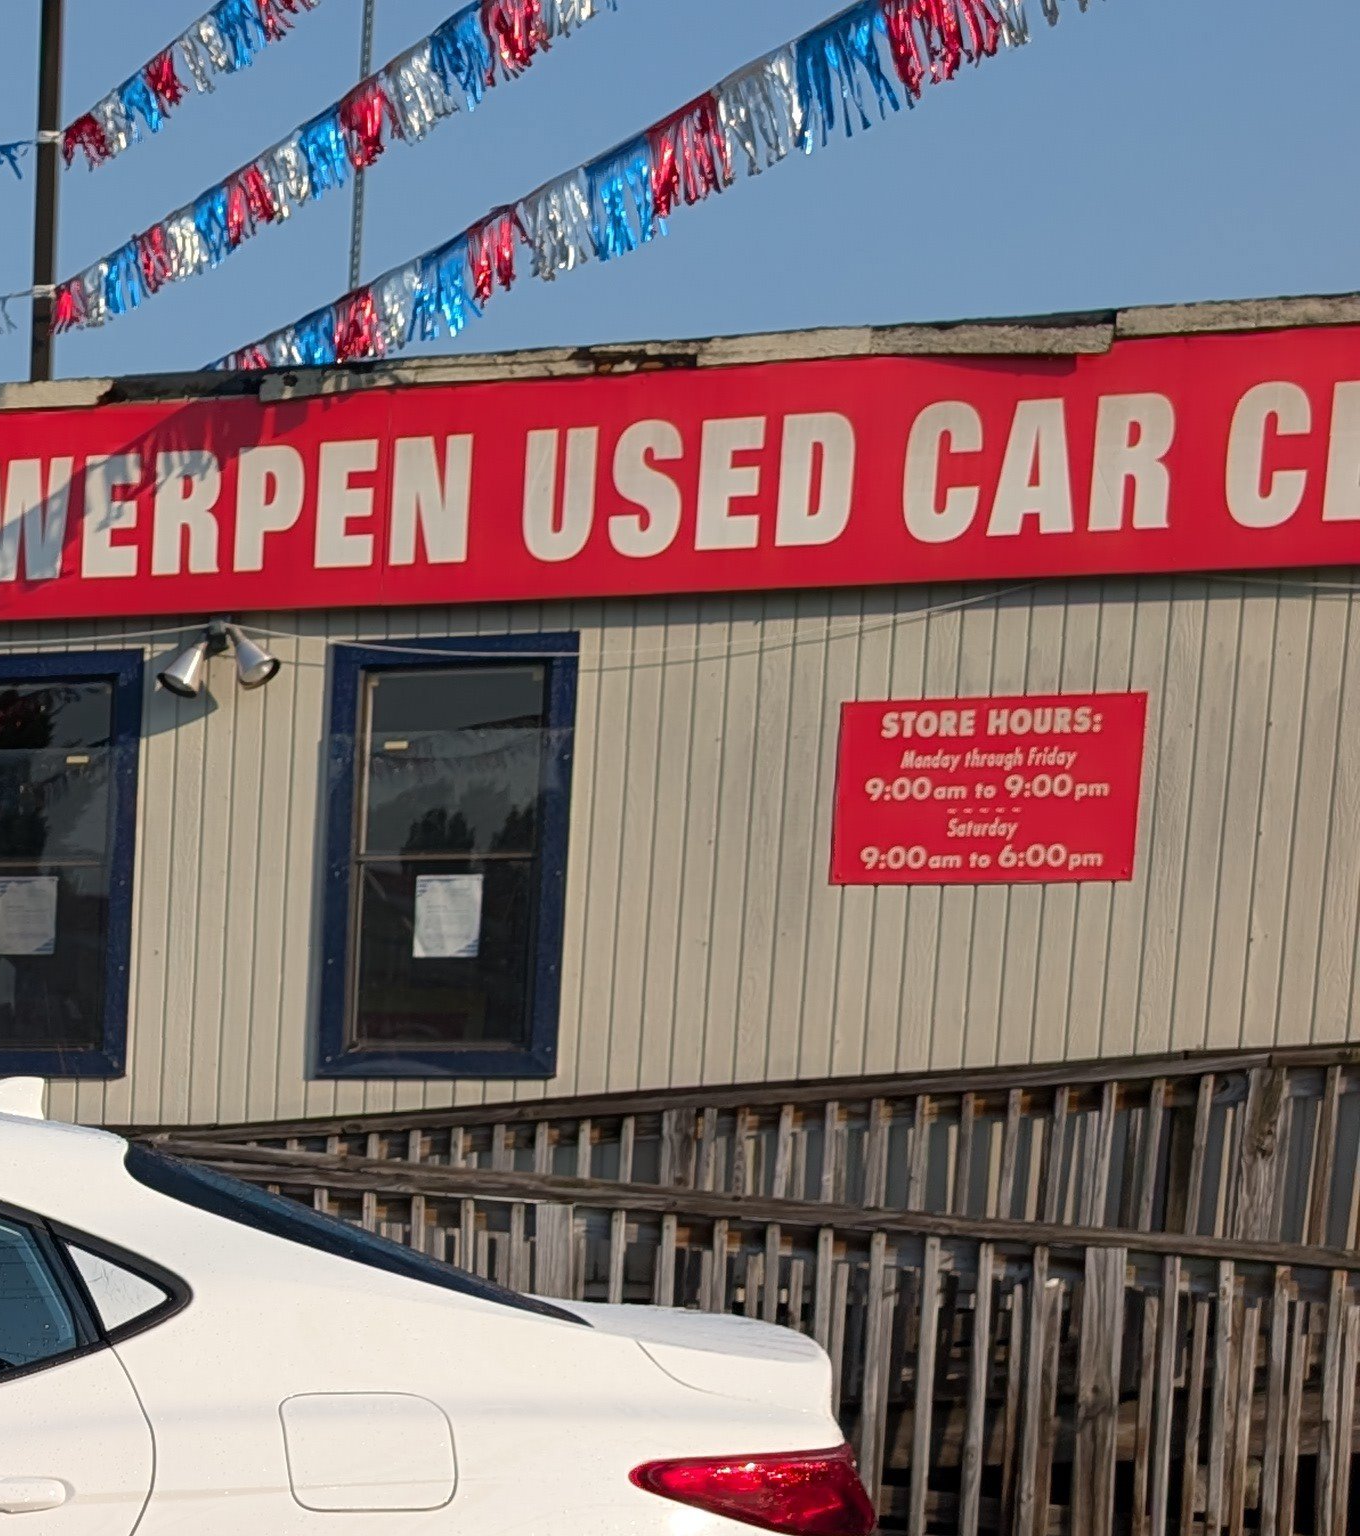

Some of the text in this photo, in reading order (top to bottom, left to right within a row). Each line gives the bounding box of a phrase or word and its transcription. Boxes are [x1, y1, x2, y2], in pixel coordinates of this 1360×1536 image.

[520, 411, 857, 563] USED
[902, 392, 1177, 544] CAR
[881, 706, 1104, 739] STORE HOURS:
[900, 746, 1077, 773] Monday through Friday
[974, 782, 997, 799] to
[947, 817, 1019, 840] Saturday
[969, 851, 991, 868] to
